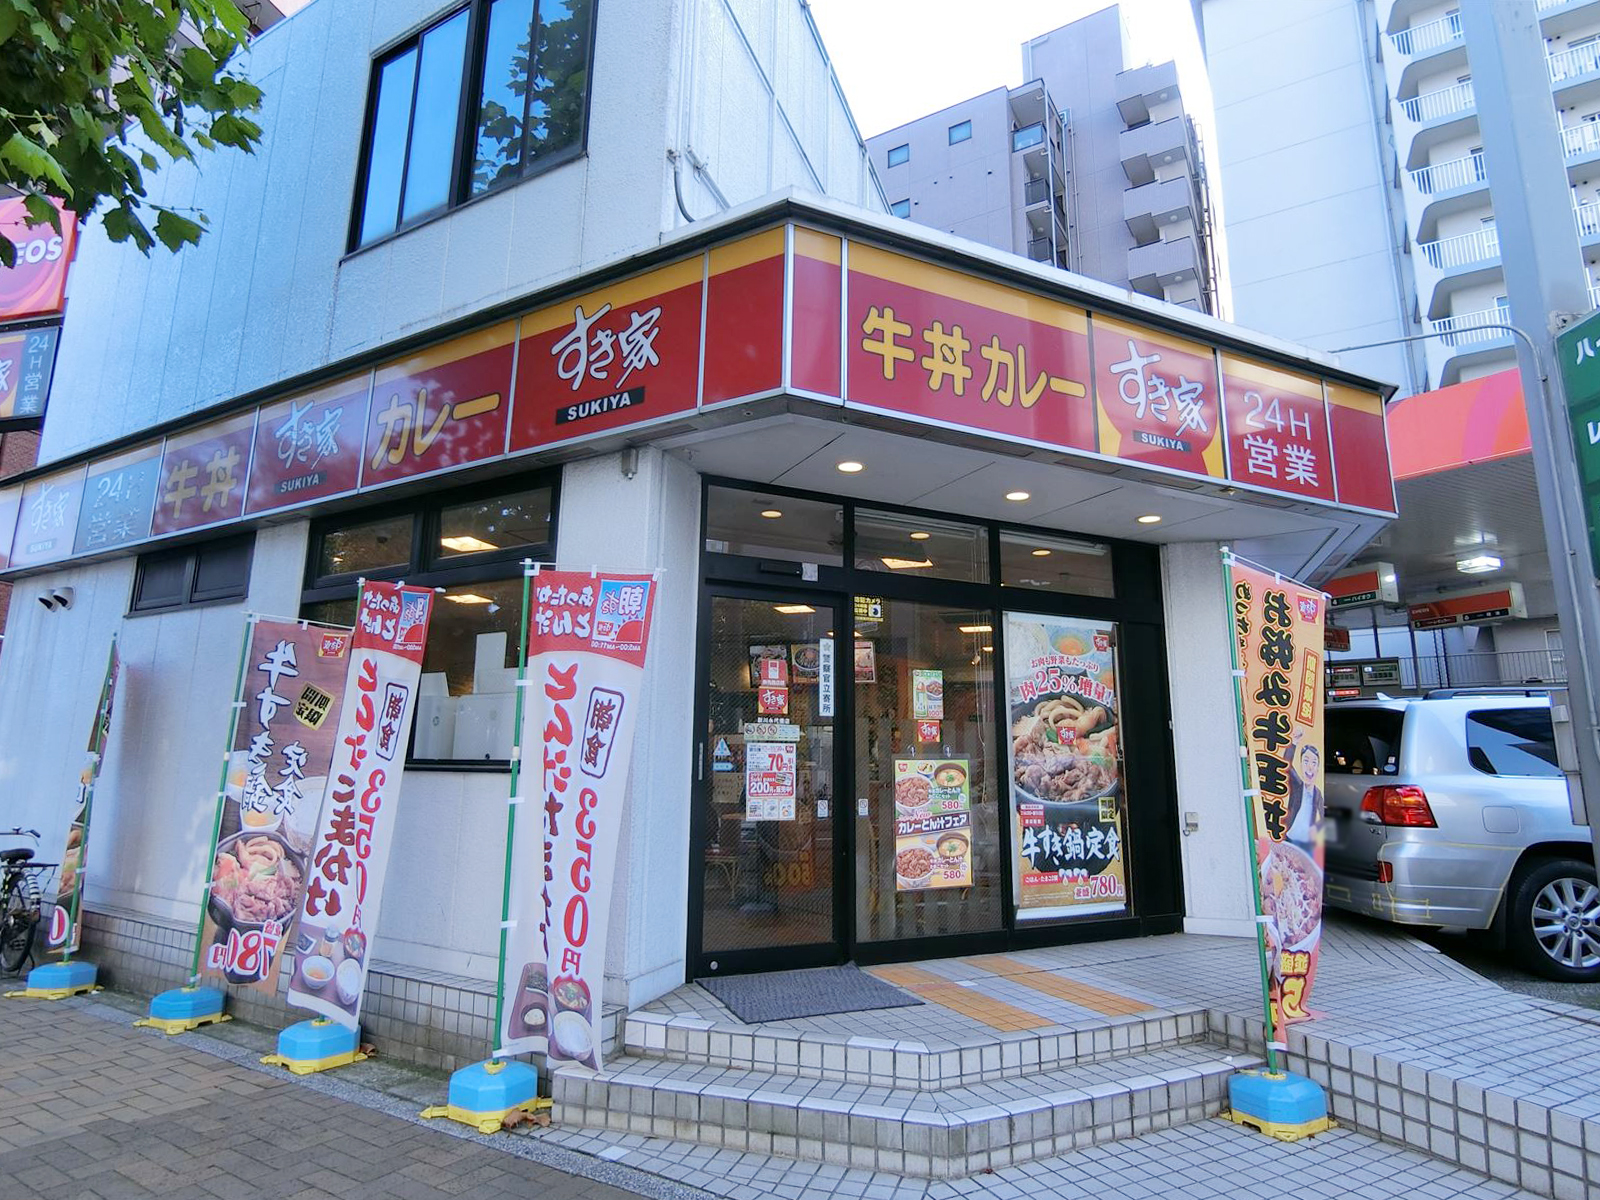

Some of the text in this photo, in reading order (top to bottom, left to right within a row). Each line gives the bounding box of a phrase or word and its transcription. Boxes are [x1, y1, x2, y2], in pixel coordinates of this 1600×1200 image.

[14, 236, 63, 266] EOS
[551, 303, 663, 391] すき家
[861, 305, 1086, 409] 牛丼カレー
[567, 394, 632, 422] SUKIYA
[1109, 339, 1210, 437] すき家
[275, 401, 344, 469] すき家
[371, 388, 501, 471] カレー
[1243, 391, 1312, 441] 24H
[1140, 432, 1185, 451] SUKIYA
[1242, 435, 1320, 488] 営業
[164, 446, 241, 519] 牛丼
[280, 473, 320, 494] SUKIYA
[898, 814, 967, 834] カレーとん汁フェア
[942, 800, 959, 809] 580
[943, 870, 961, 880] 580
